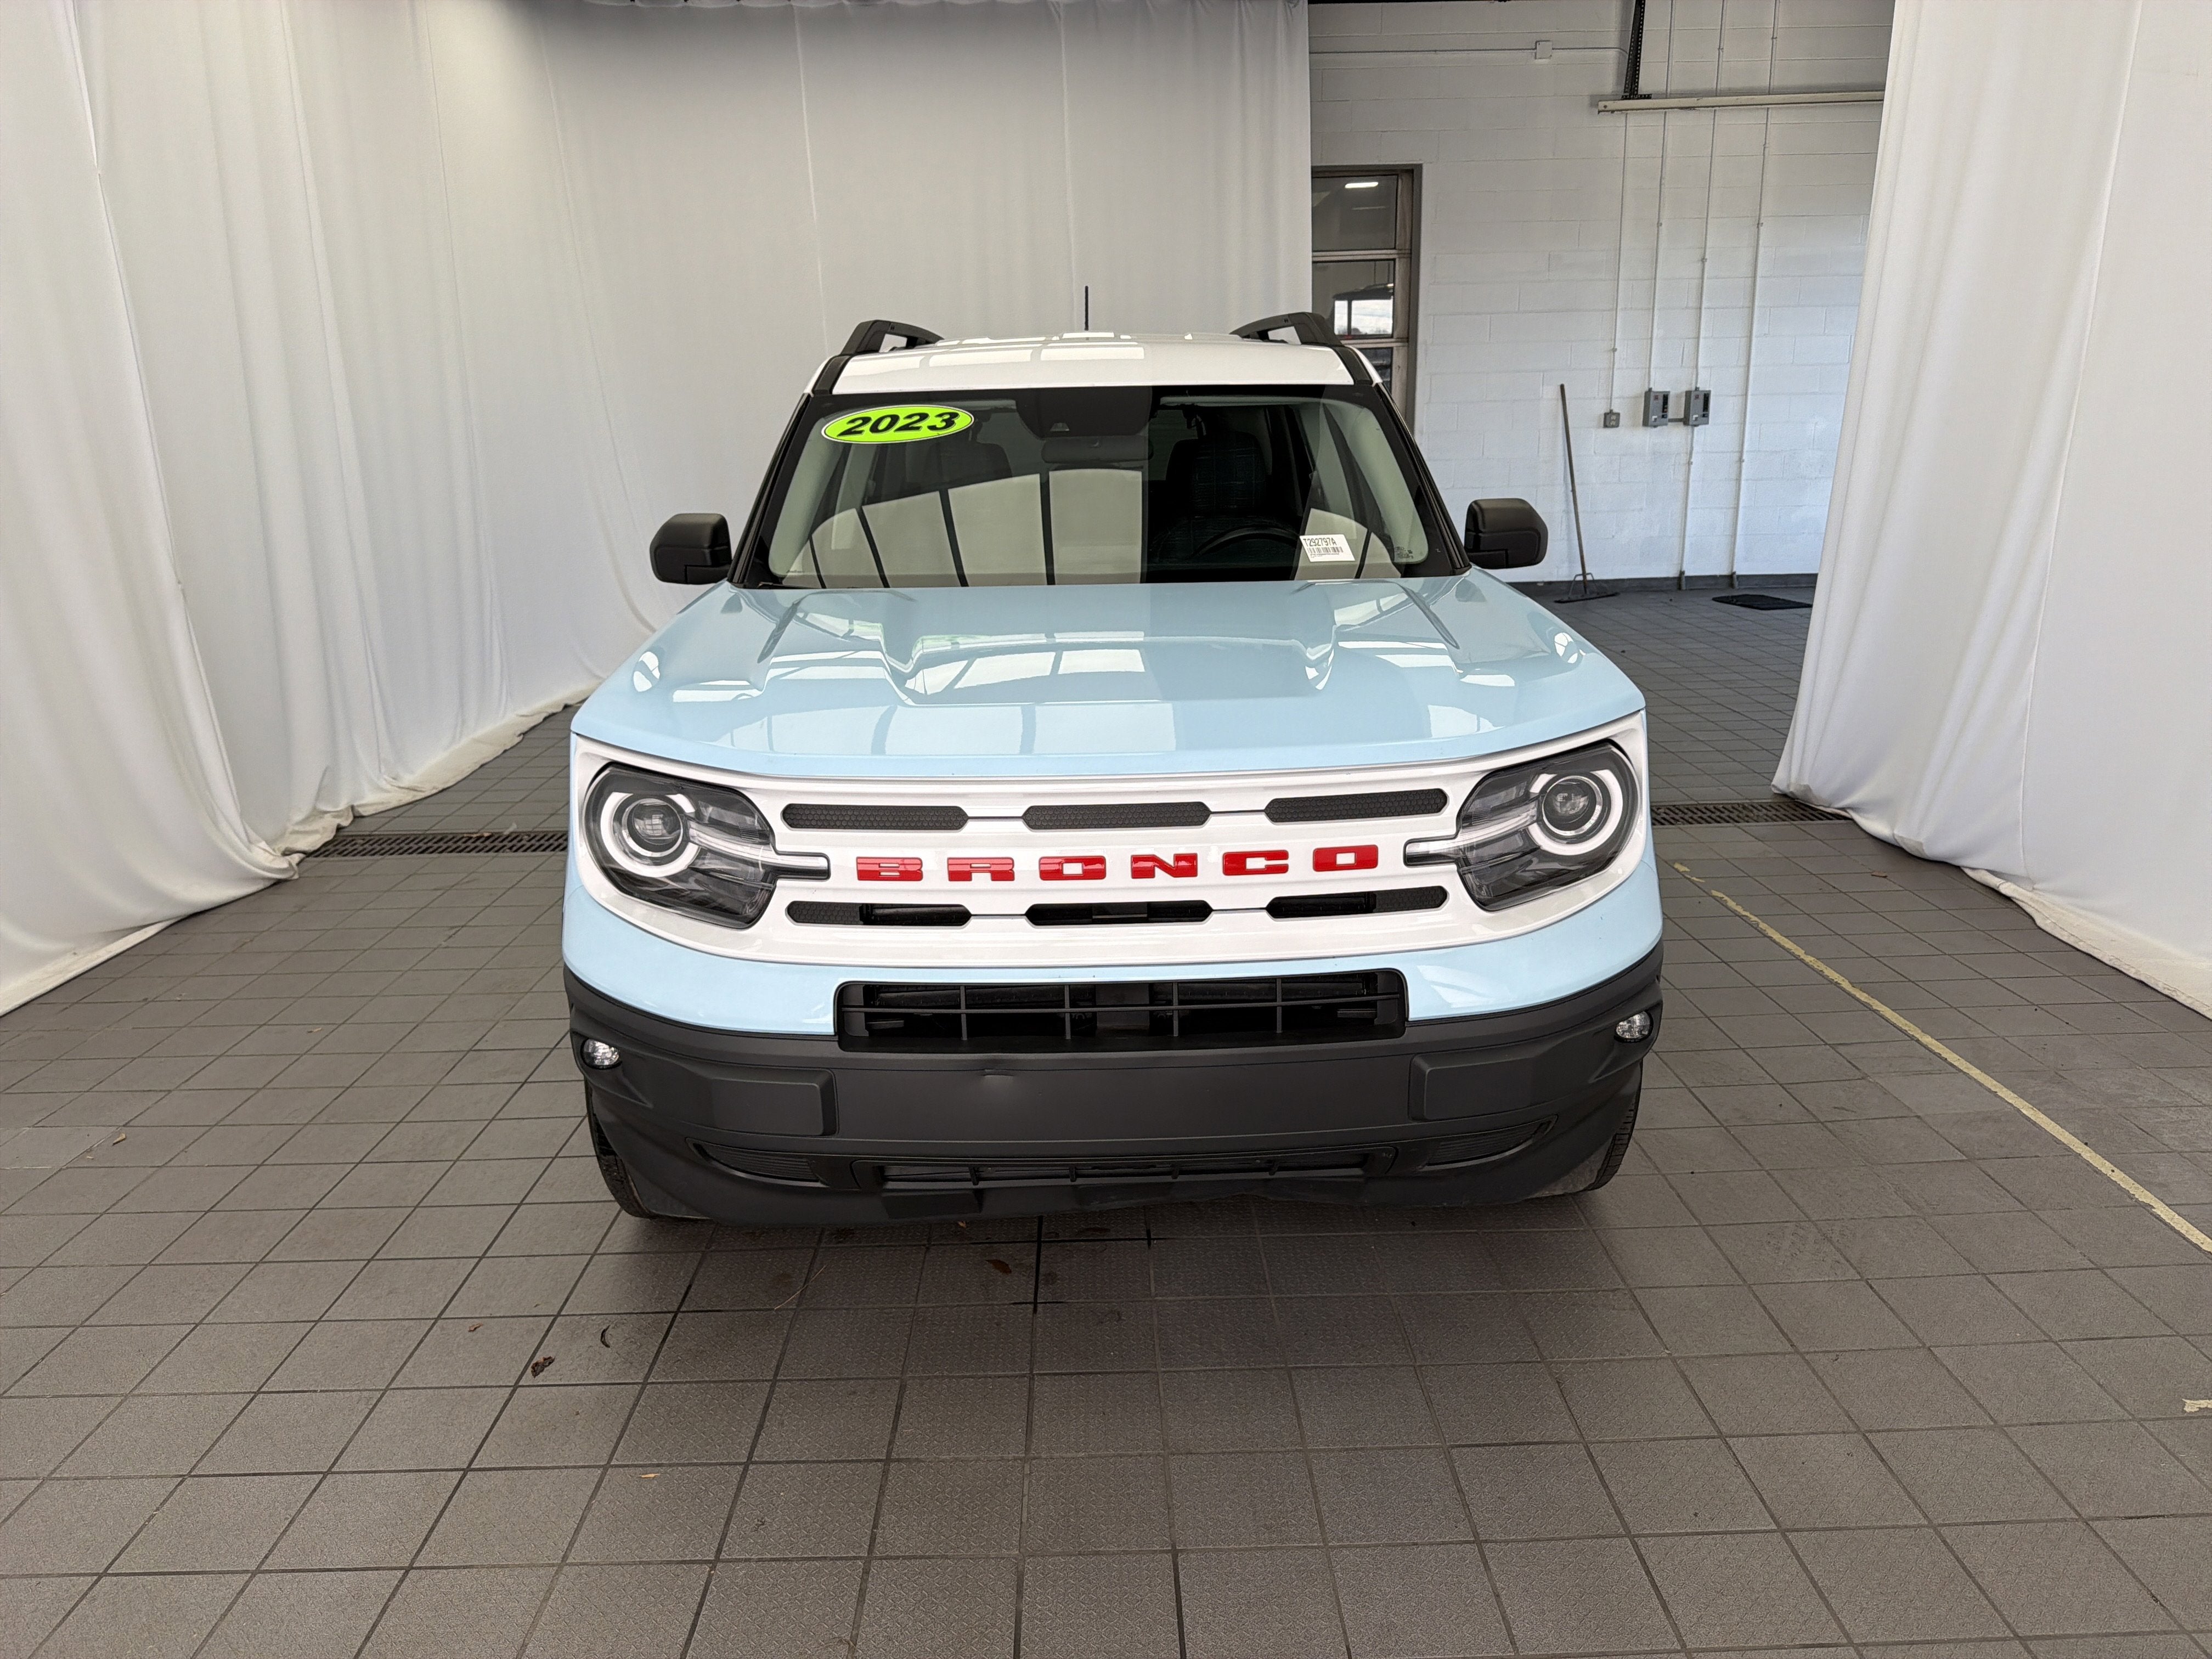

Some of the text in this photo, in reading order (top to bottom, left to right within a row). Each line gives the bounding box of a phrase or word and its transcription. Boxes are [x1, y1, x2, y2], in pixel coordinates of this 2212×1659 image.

[837, 411, 960, 437] 2023
[1303, 537, 1337, 547] T292797A
[856, 844, 1379, 882] BRONCO
